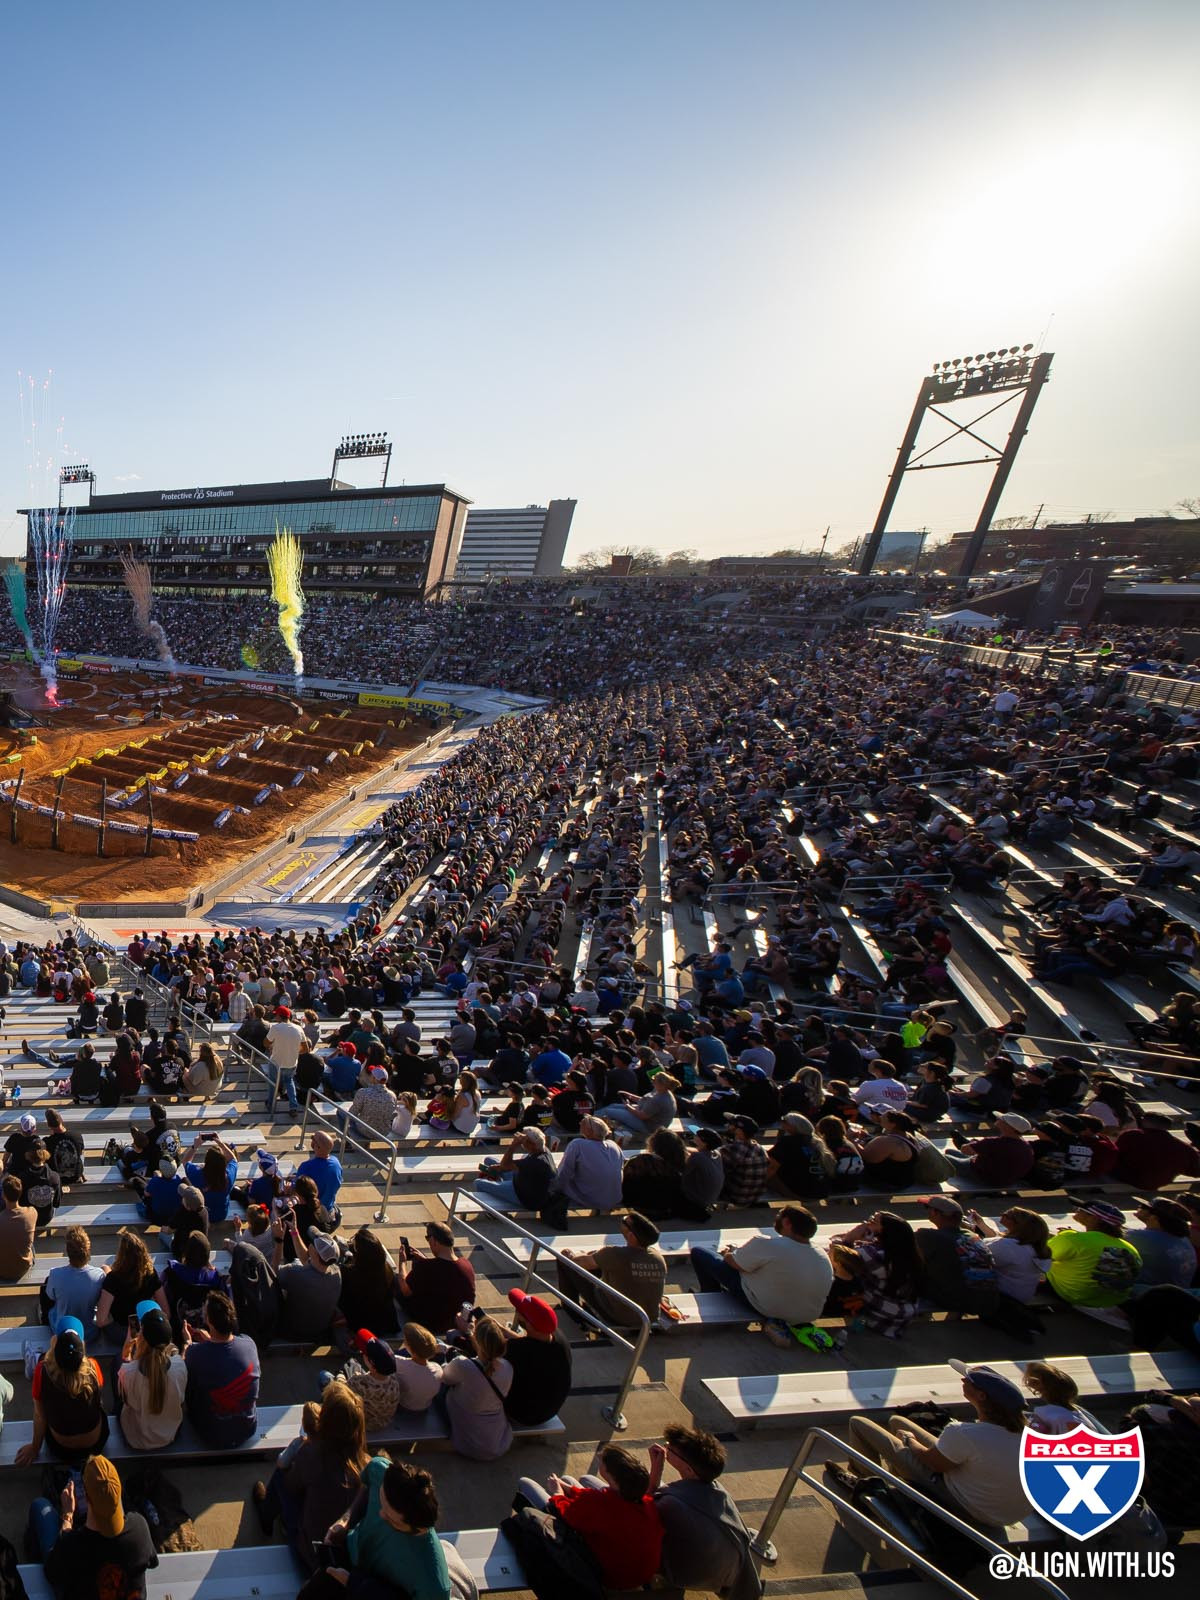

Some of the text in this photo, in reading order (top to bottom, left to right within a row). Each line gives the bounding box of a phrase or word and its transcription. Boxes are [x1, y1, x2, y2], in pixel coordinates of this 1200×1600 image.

[161, 489, 234, 501] Protective Stadium
[143, 537, 160, 545] HOME
[177, 536, 190, 544] THE
[195, 536, 208, 544] UAB
[213, 535, 247, 544] BLAZERS
